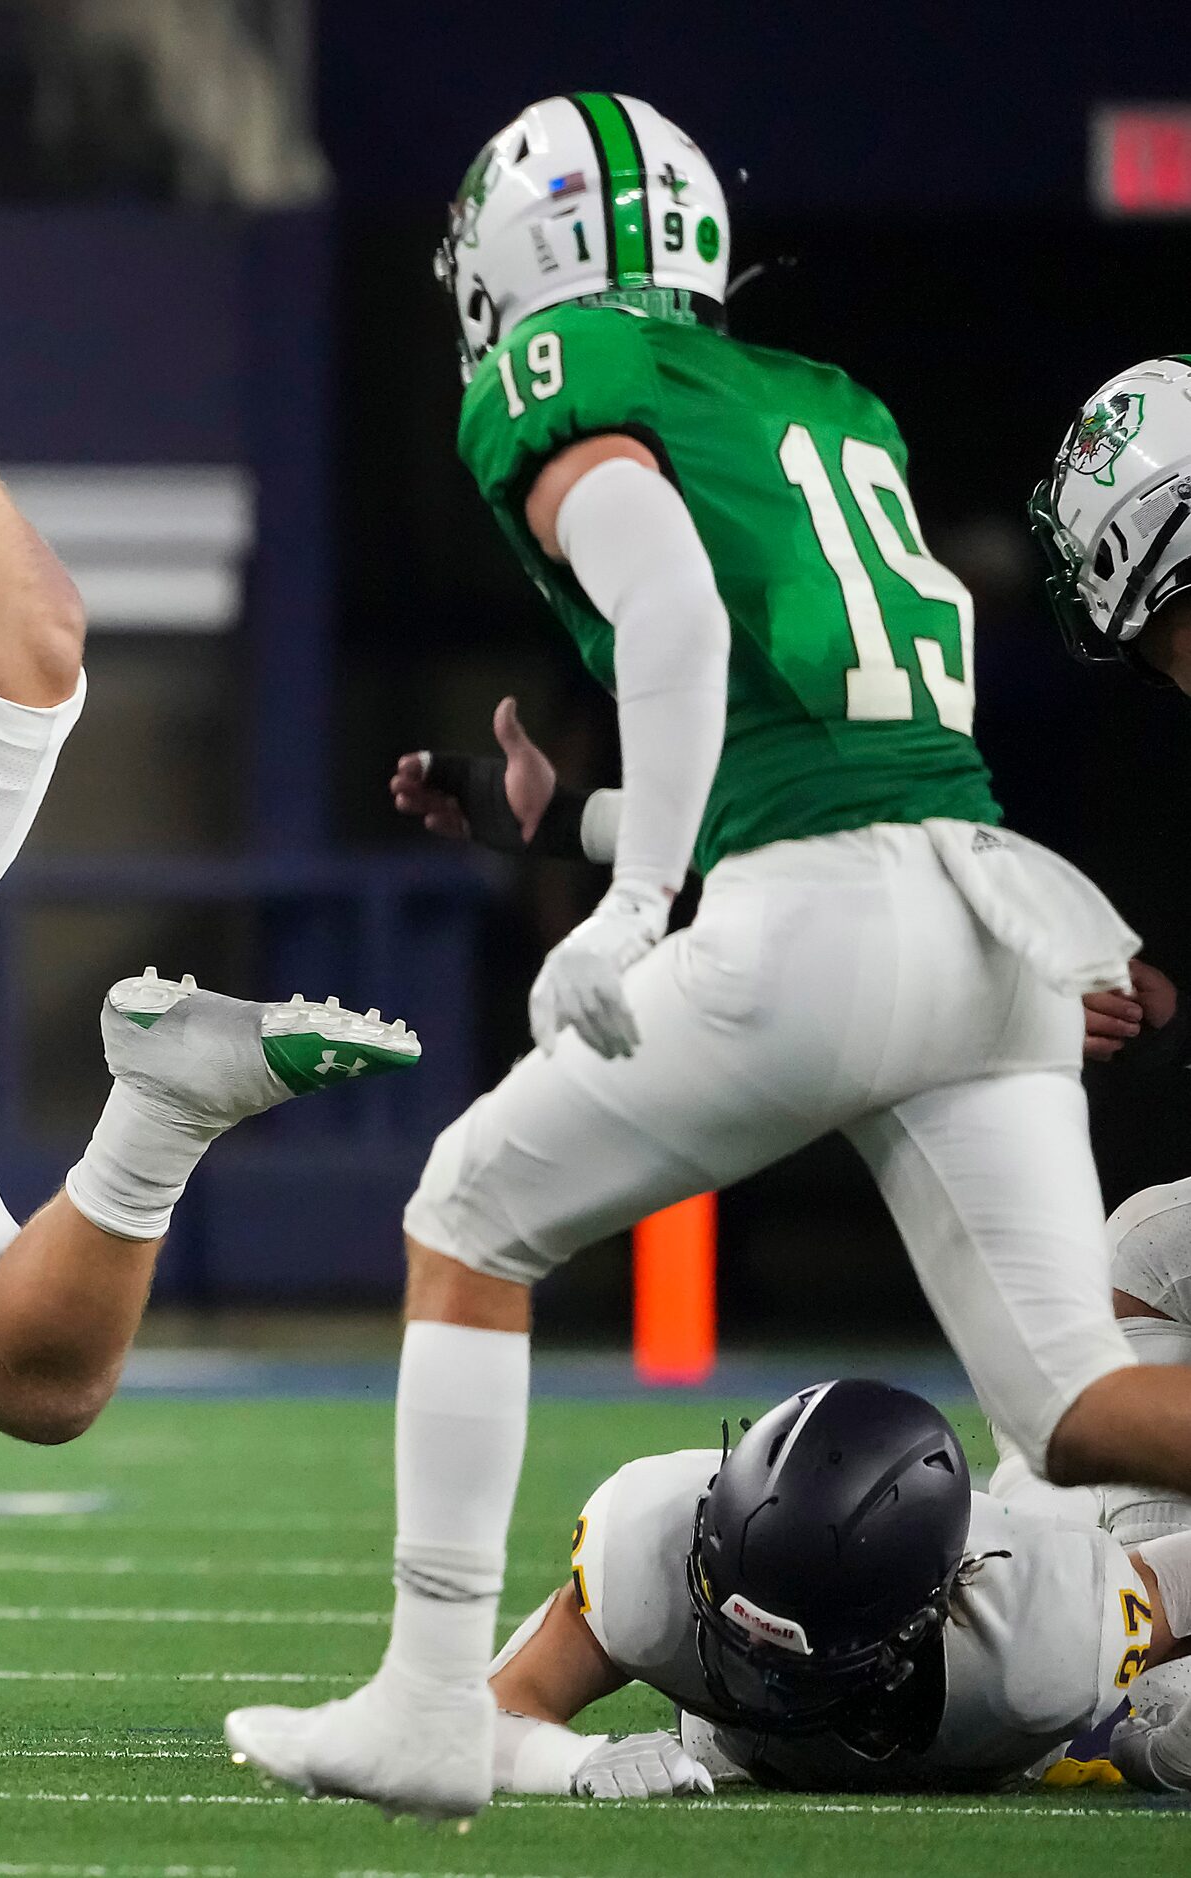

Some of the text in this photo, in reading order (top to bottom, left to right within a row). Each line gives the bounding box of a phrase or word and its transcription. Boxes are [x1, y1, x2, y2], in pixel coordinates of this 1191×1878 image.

[573, 220, 590, 262] 1
[664, 211, 684, 252] 9
[498, 331, 563, 418] 19
[778, 422, 975, 738] 19
